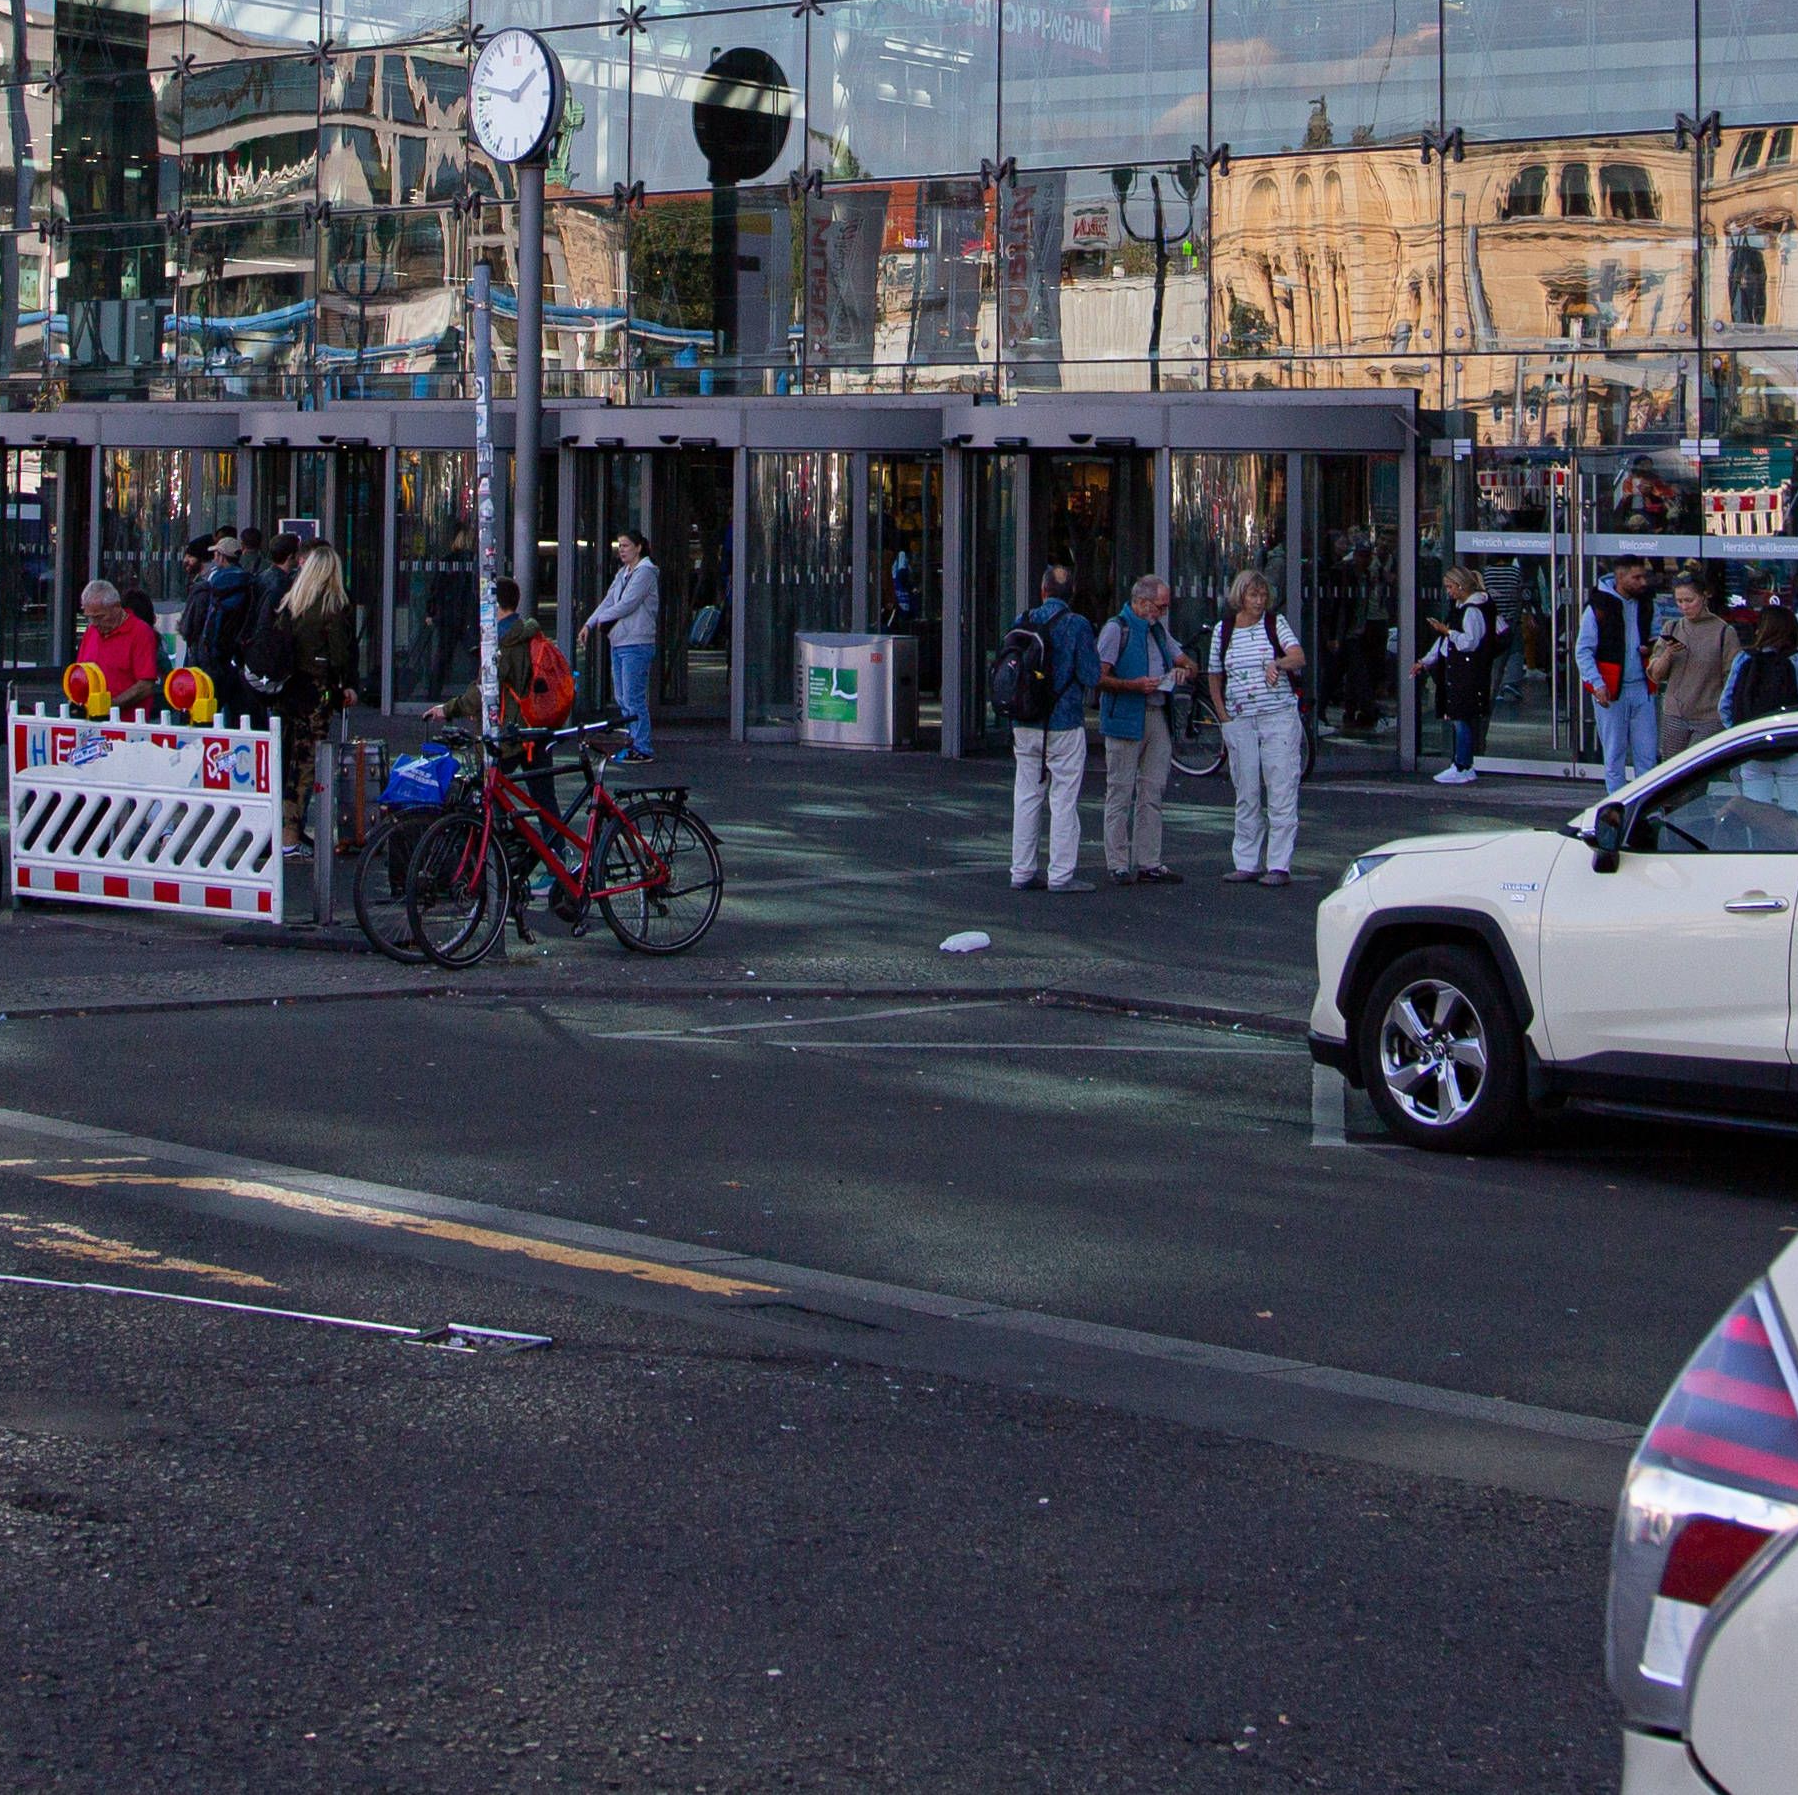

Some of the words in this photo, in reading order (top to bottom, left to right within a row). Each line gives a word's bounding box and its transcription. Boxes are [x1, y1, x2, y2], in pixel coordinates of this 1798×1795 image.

[1471, 537, 1502, 549] Herzlich
[1618, 539, 1659, 552] Welcome!
[1722, 540, 1757, 554] Herzlich
[795, 663, 805, 724] Abfall
